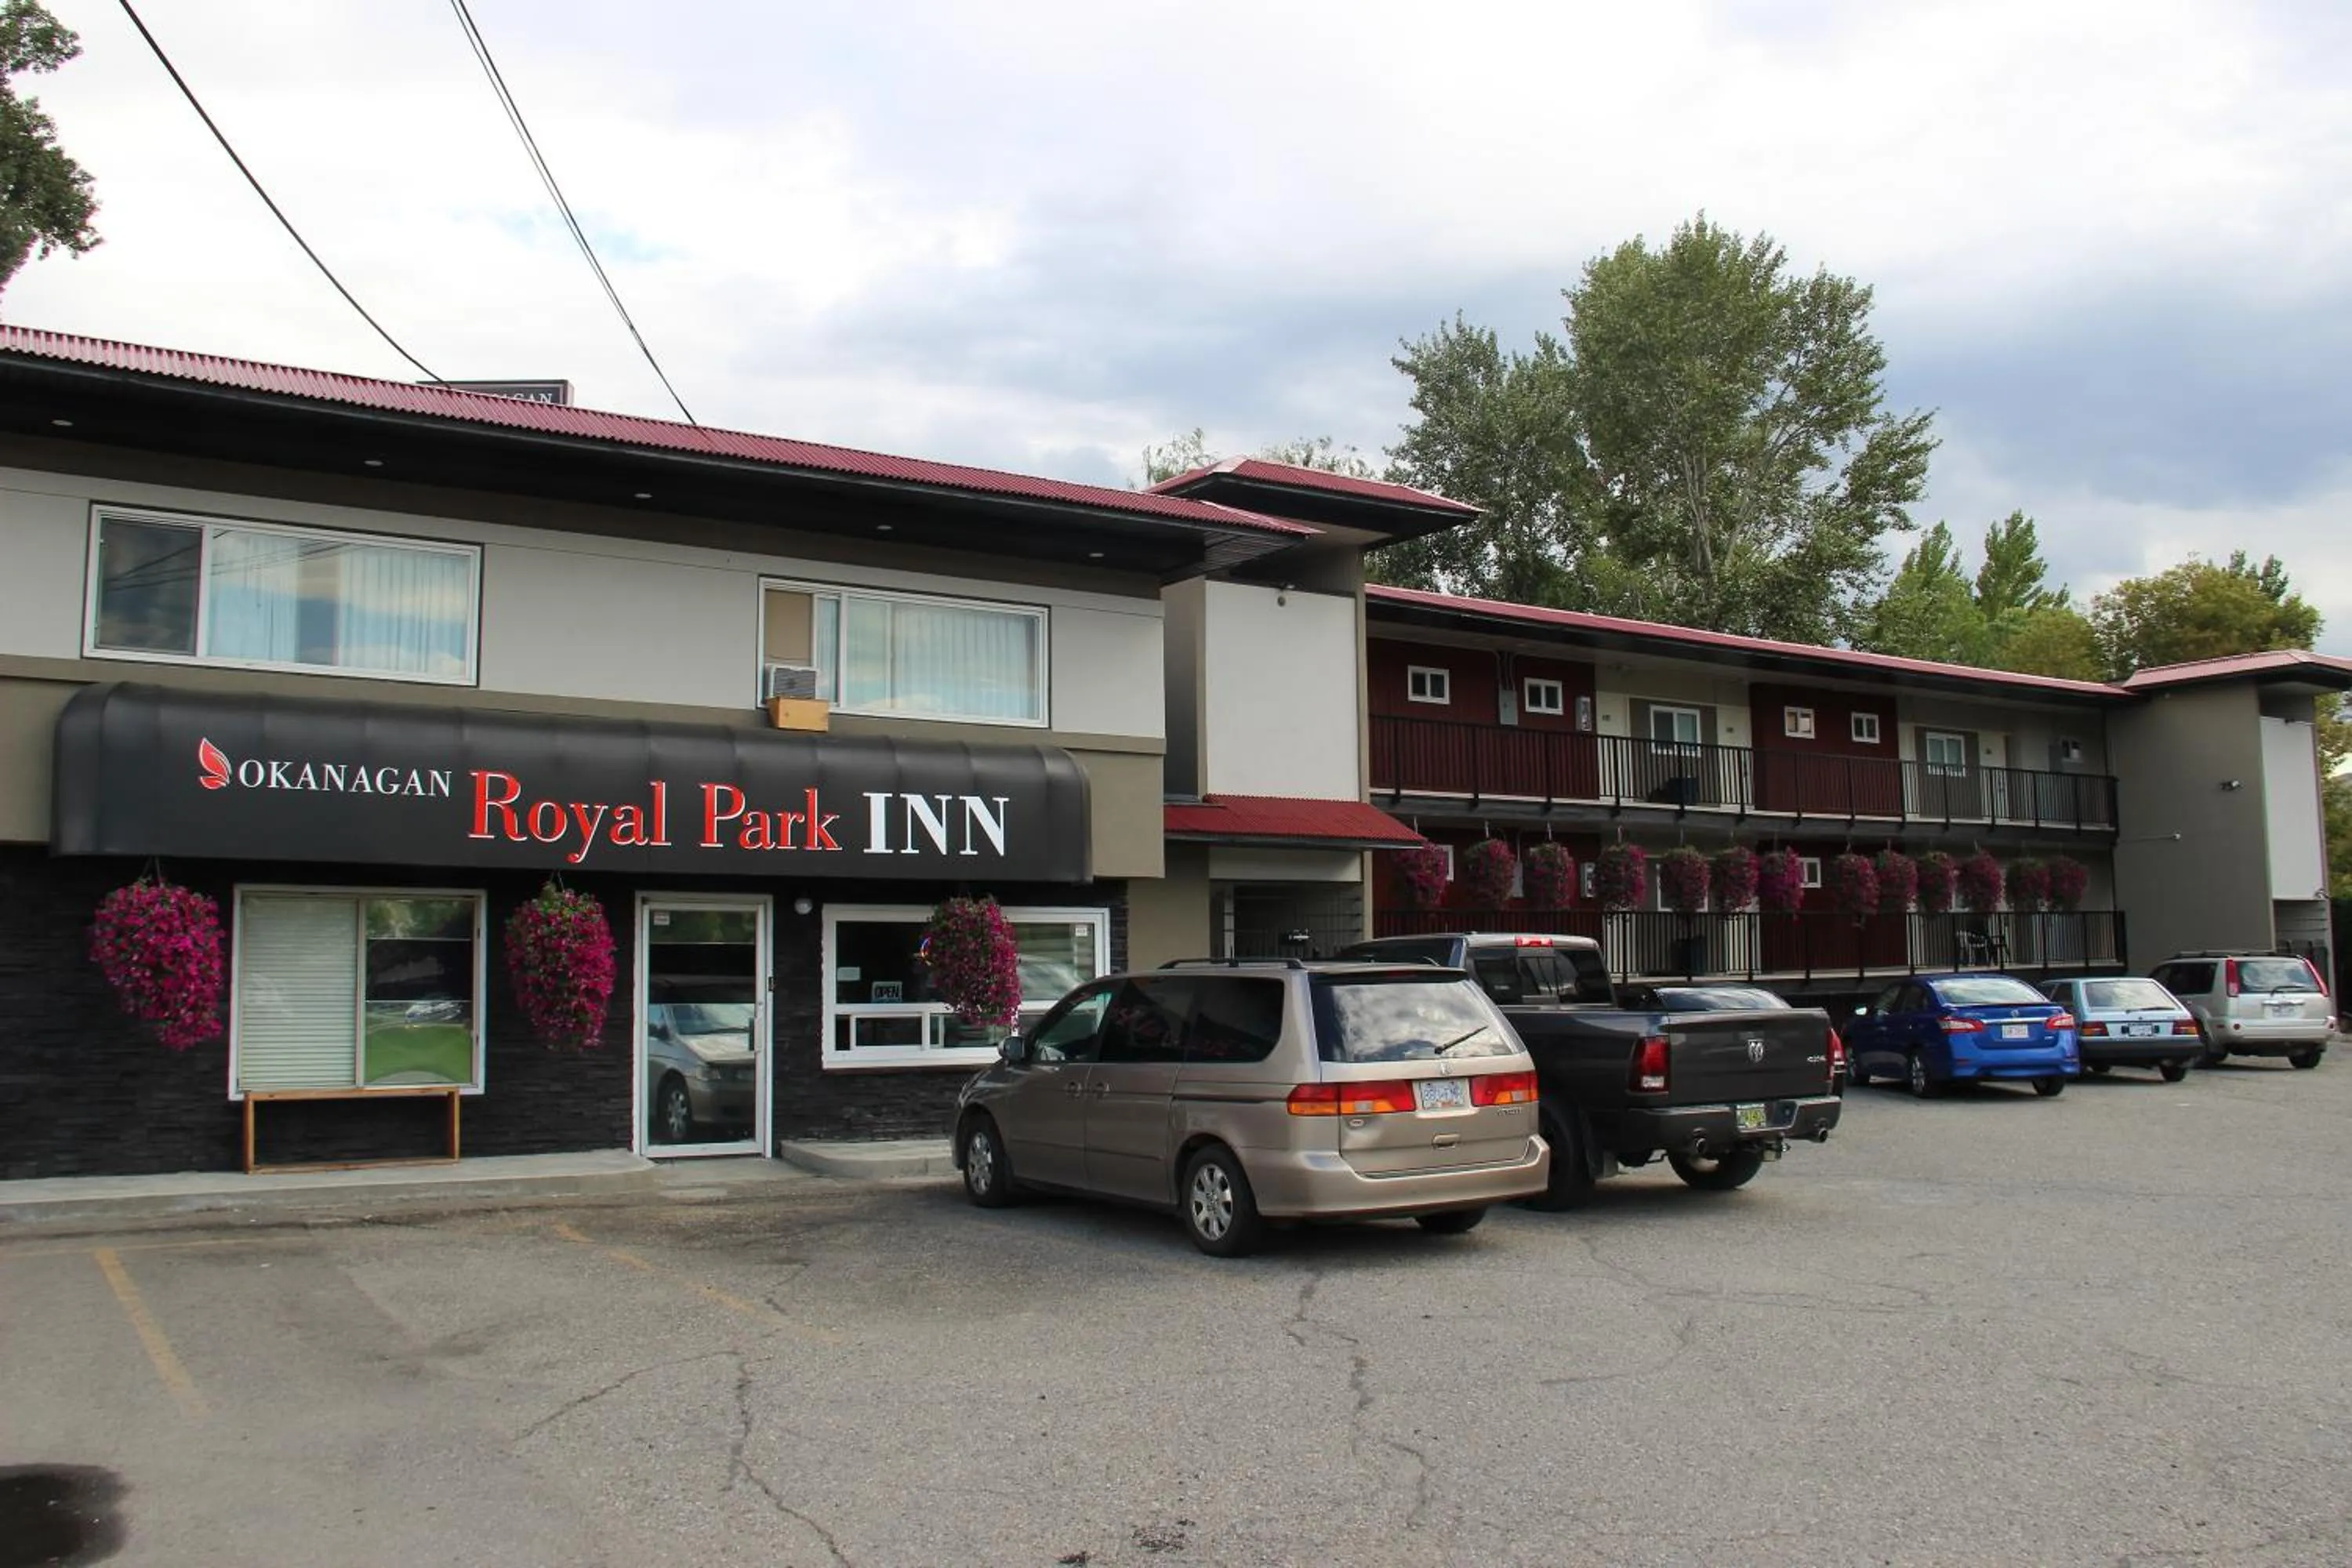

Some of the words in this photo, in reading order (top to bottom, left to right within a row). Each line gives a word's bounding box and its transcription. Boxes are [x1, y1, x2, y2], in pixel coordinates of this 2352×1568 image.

[238, 760, 452, 797] OKANAGAN
[468, 770, 672, 863] Royal
[700, 783, 843, 851] Park
[863, 793, 1010, 856] INN
[875, 983, 899, 999] OPEN
